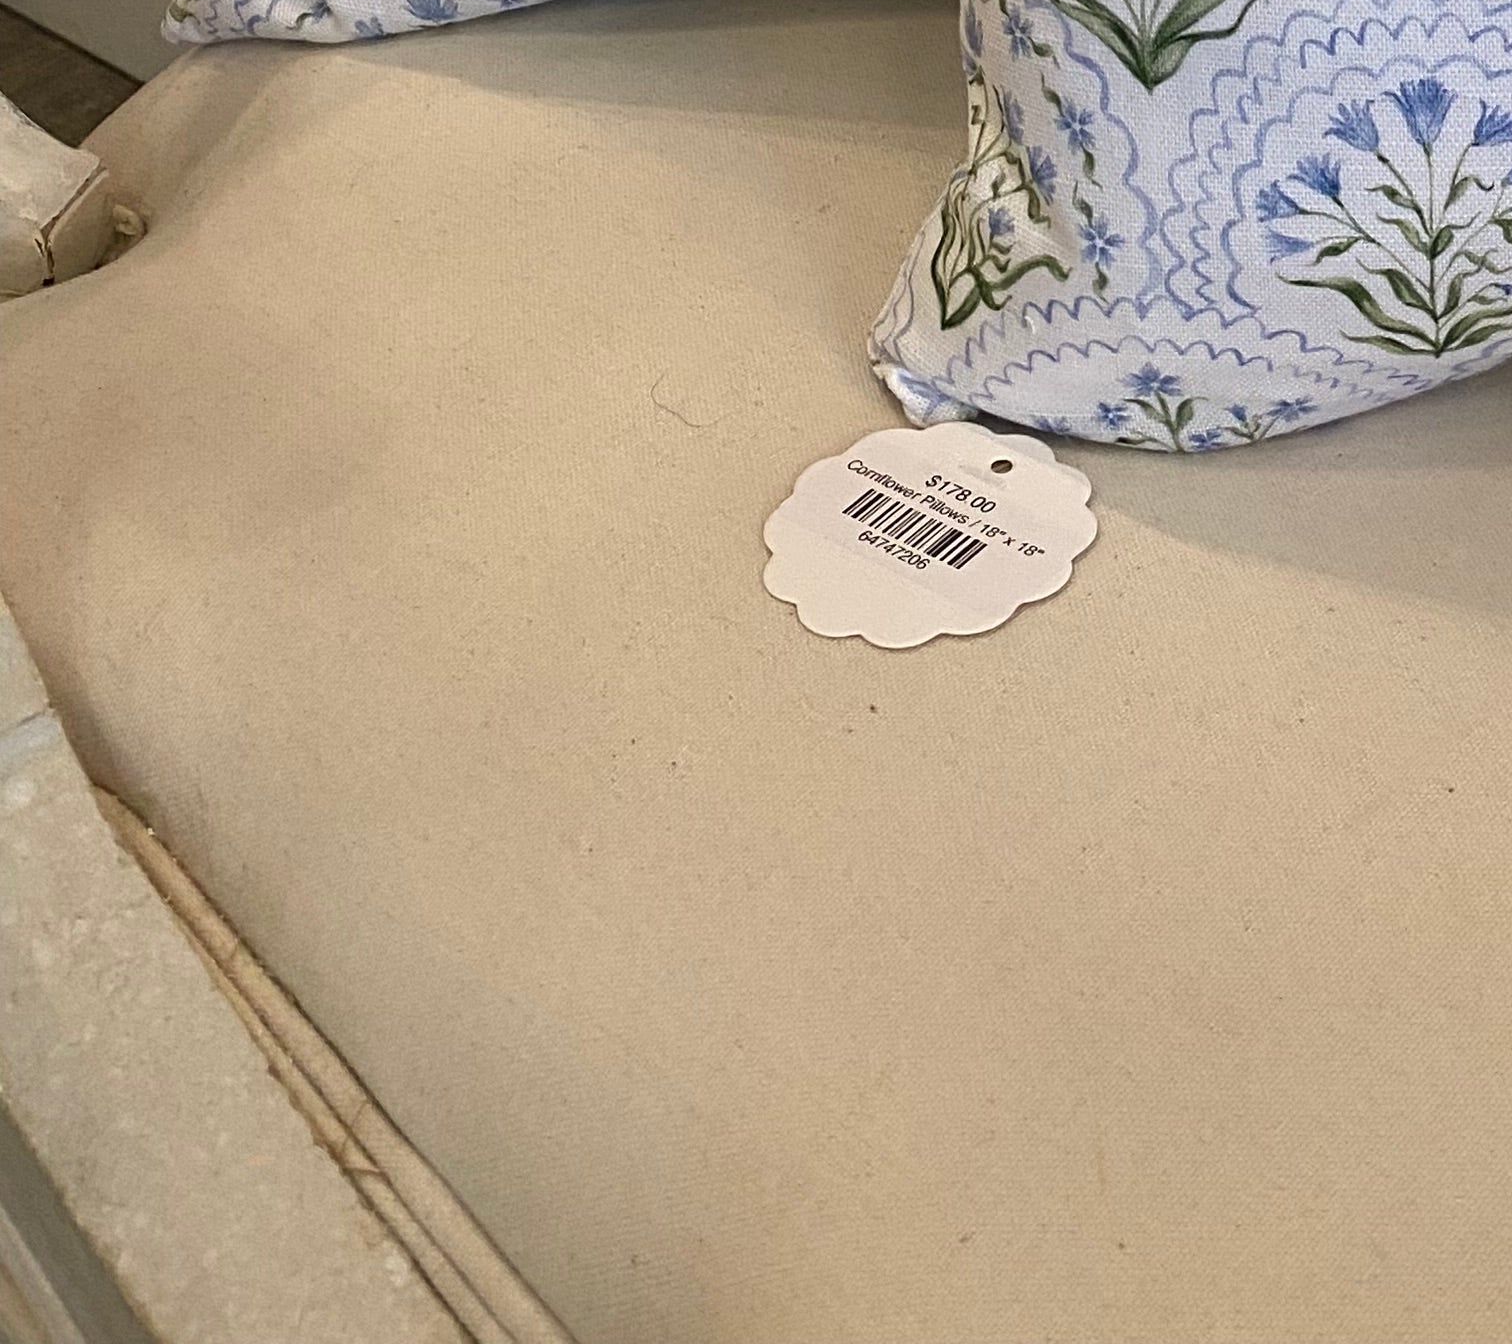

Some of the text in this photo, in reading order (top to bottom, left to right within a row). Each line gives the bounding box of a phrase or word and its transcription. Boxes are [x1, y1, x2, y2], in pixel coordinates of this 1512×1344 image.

[847, 459, 922, 500] Cornflower
[920, 494, 970, 525] Pillows
[979, 524, 1006, 539] 18"
[1003, 536, 1016, 547] x
[1017, 542, 1046, 557] 18"
[925, 475, 997, 514] $178.00
[858, 530, 931, 570] 64747206
